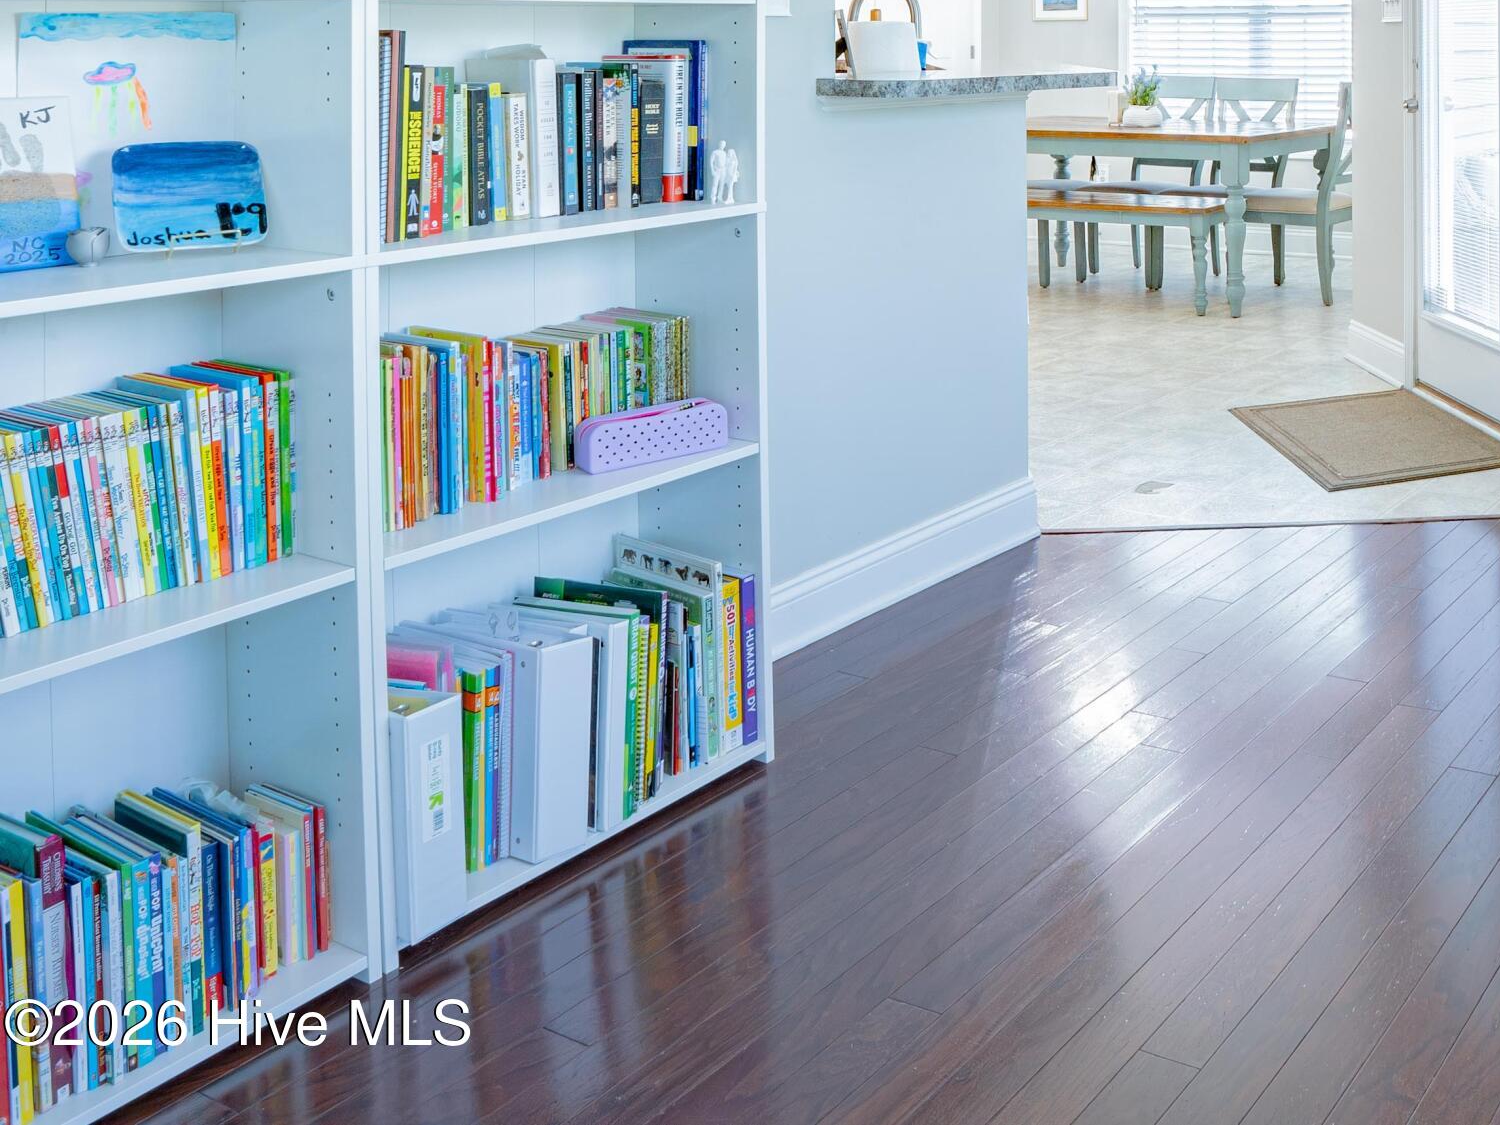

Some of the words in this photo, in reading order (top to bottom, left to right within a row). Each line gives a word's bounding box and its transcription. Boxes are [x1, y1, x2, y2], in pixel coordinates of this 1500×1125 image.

[584, 77, 592, 110] Brilliant
[677, 83, 683, 91] IN
[476, 102, 485, 141] POCKET
[567, 116, 574, 127] IT
[584, 112, 592, 148] Blunders
[676, 107, 684, 127] HOLE!
[407, 120, 421, 172] SCIENCE
[567, 128, 575, 142] ALL
[477, 142, 485, 168] BIBLE
[477, 171, 486, 200] ATLAS
[127, 227, 211, 246] Joshua
[4, 247, 60, 266] 2025
[195, 470, 203, 487] HAPPY
[197, 502, 205, 524] DAY!
[7, 507, 18, 527] HOP
[13, 537, 24, 557] POP
[69, 542, 77, 555] Go!
[726, 603, 735, 626] 501
[630, 617, 639, 645] BRAIN
[629, 646, 638, 686] QUEST
[745, 628, 755, 678] HUMAN
[206, 853, 213, 864] On
[42, 855, 53, 894] TREASURY
[53, 852, 63, 892] CHILDREN'S
[205, 879, 213, 895] Special
[150, 891, 160, 910] POP
[206, 896, 214, 911] Night
[49, 912, 63, 955] NURSERY
[150, 916, 164, 973] Unicorn!
[51, 958, 65, 999] RHYMES
